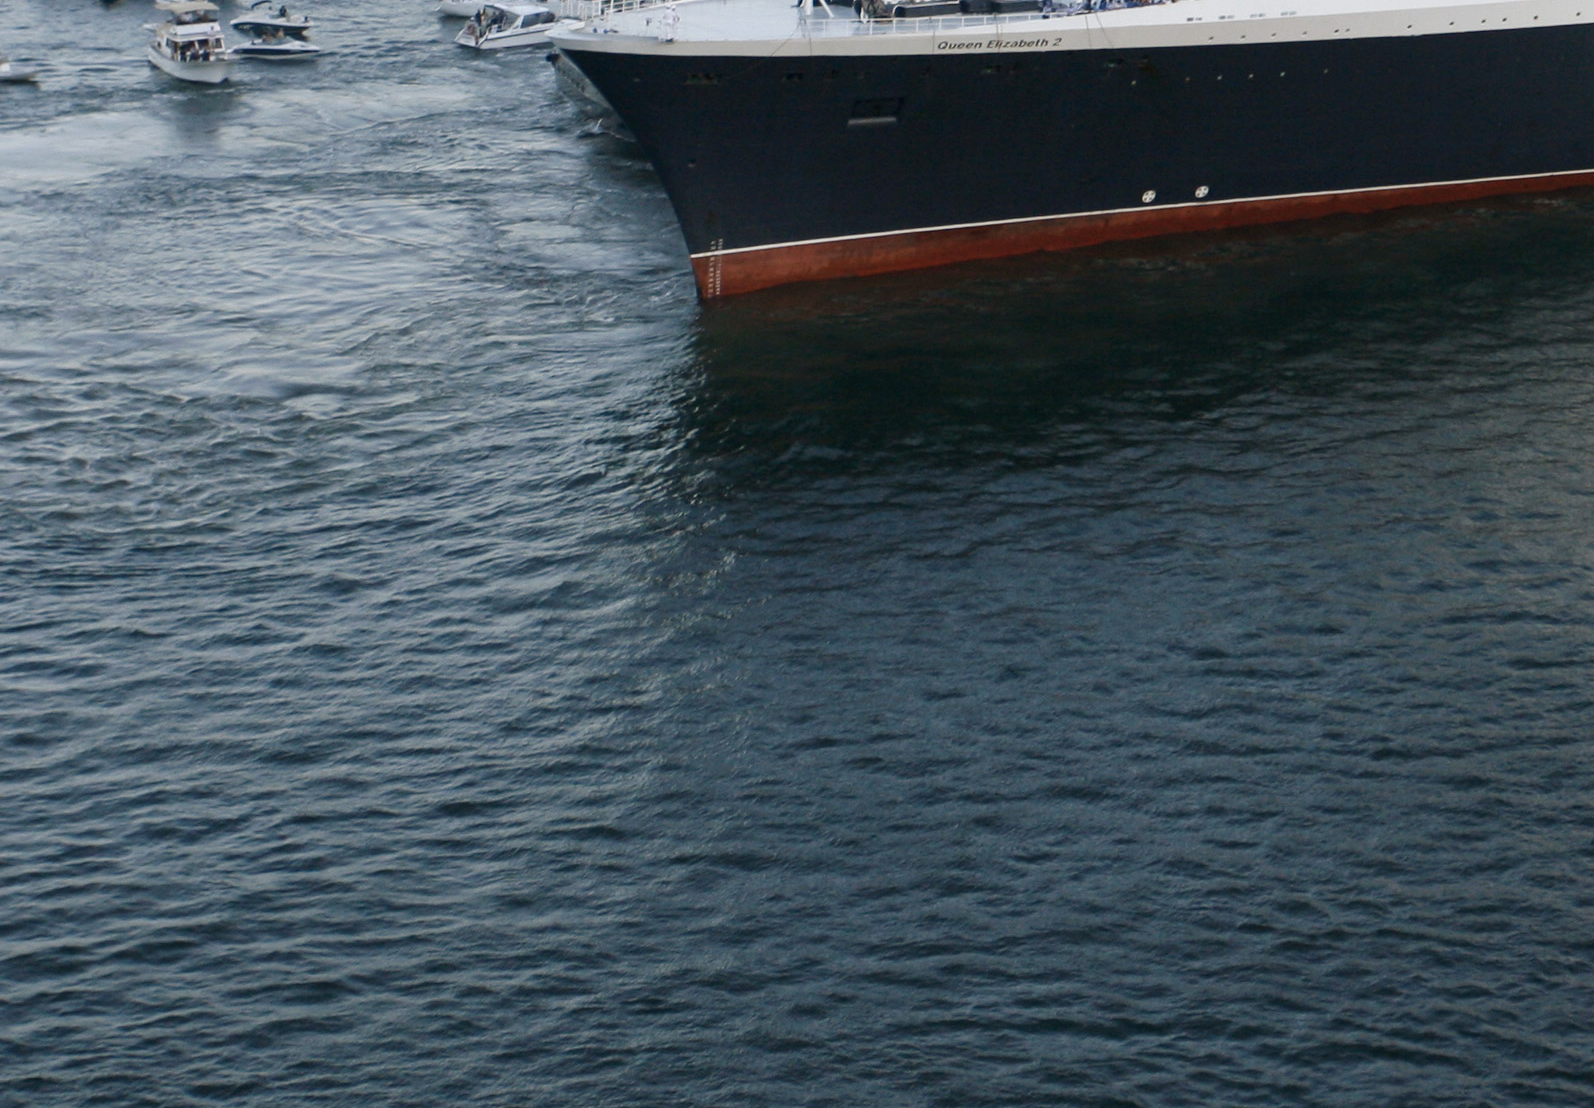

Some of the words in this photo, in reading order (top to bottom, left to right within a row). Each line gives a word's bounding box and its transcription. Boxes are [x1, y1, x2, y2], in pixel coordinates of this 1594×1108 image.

[937, 40, 983, 50] Queen
[986, 38, 1049, 49] Elizabeth
[1052, 37, 1063, 47] 2
